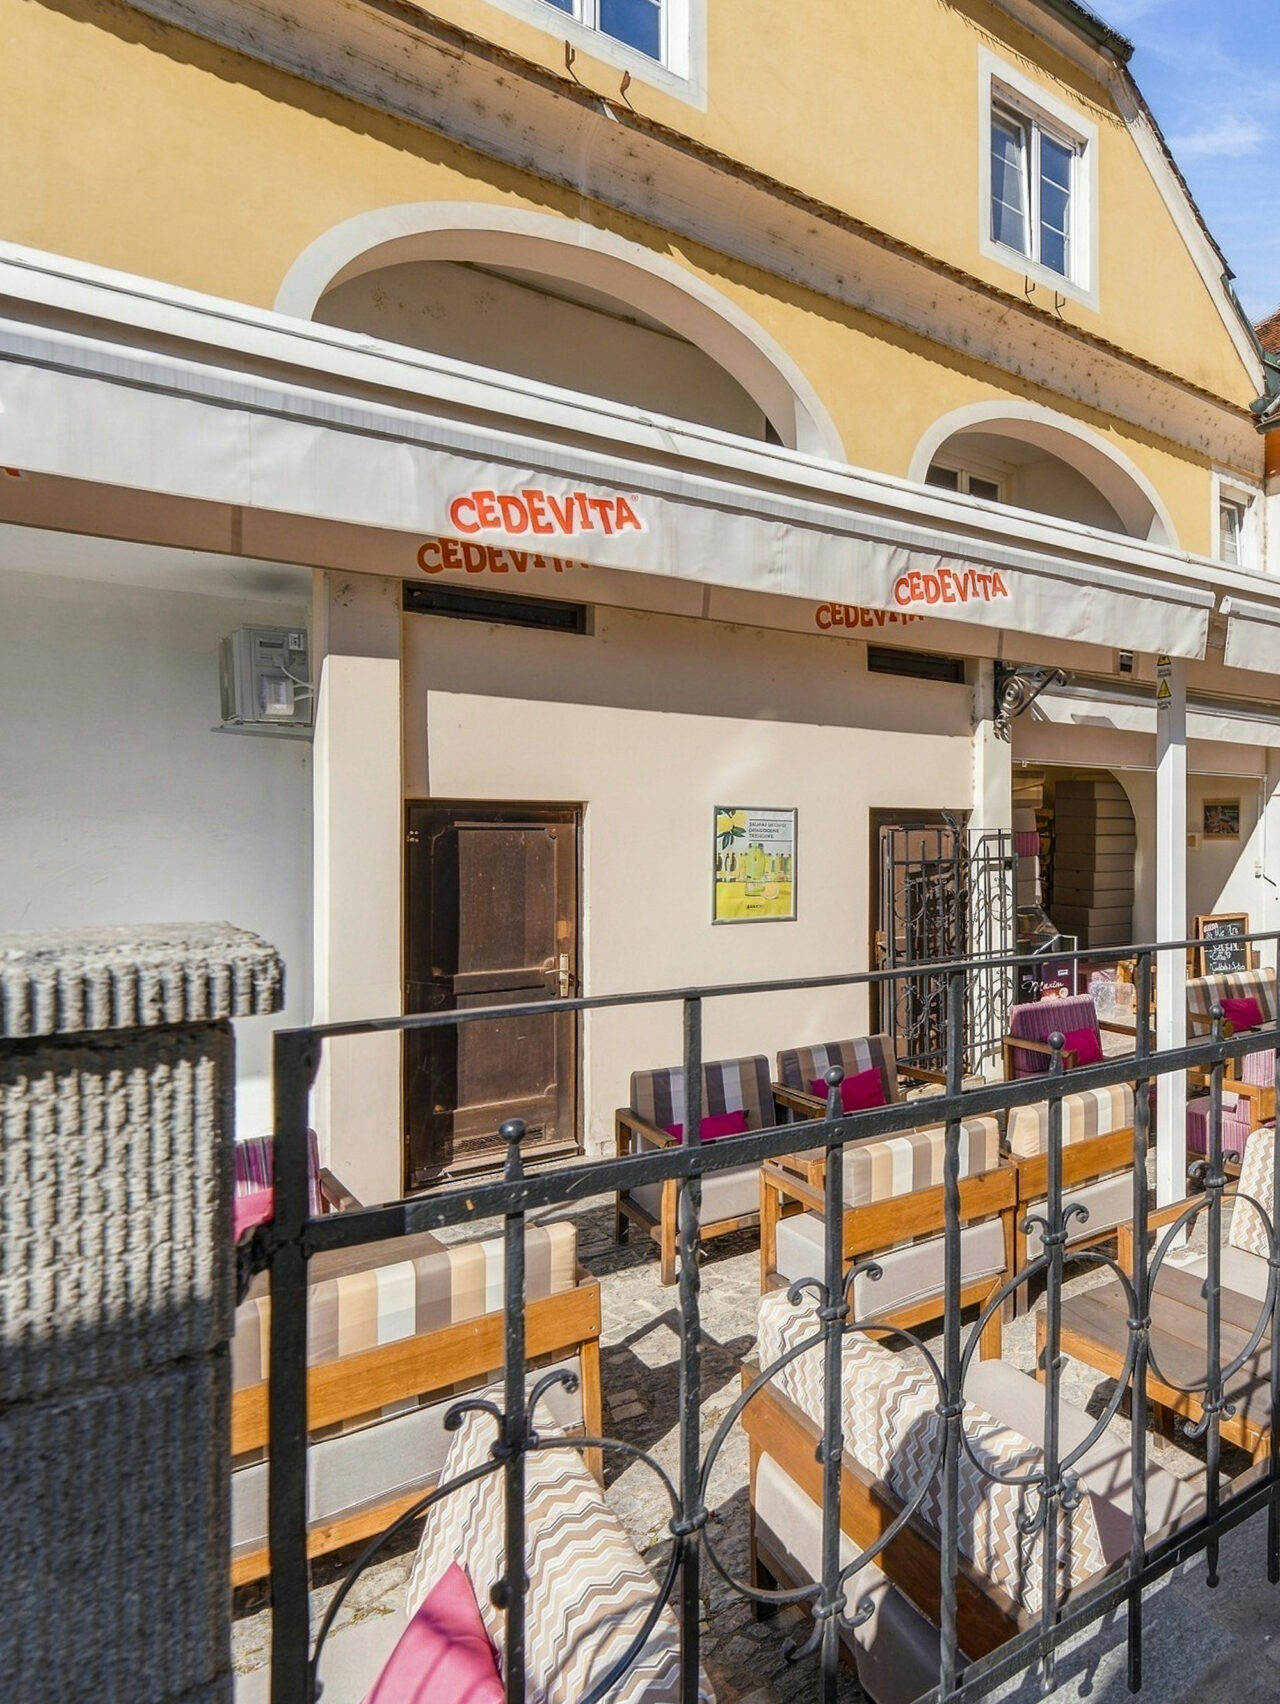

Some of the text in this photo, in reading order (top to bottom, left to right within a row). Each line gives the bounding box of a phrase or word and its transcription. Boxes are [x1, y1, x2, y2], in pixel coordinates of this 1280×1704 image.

[450, 489, 642, 535] CEDEVITA
[416, 536, 589, 575] CEDEV
[894, 569, 1008, 606] CEDEVITA
[815, 602, 924, 631] CEDEV
